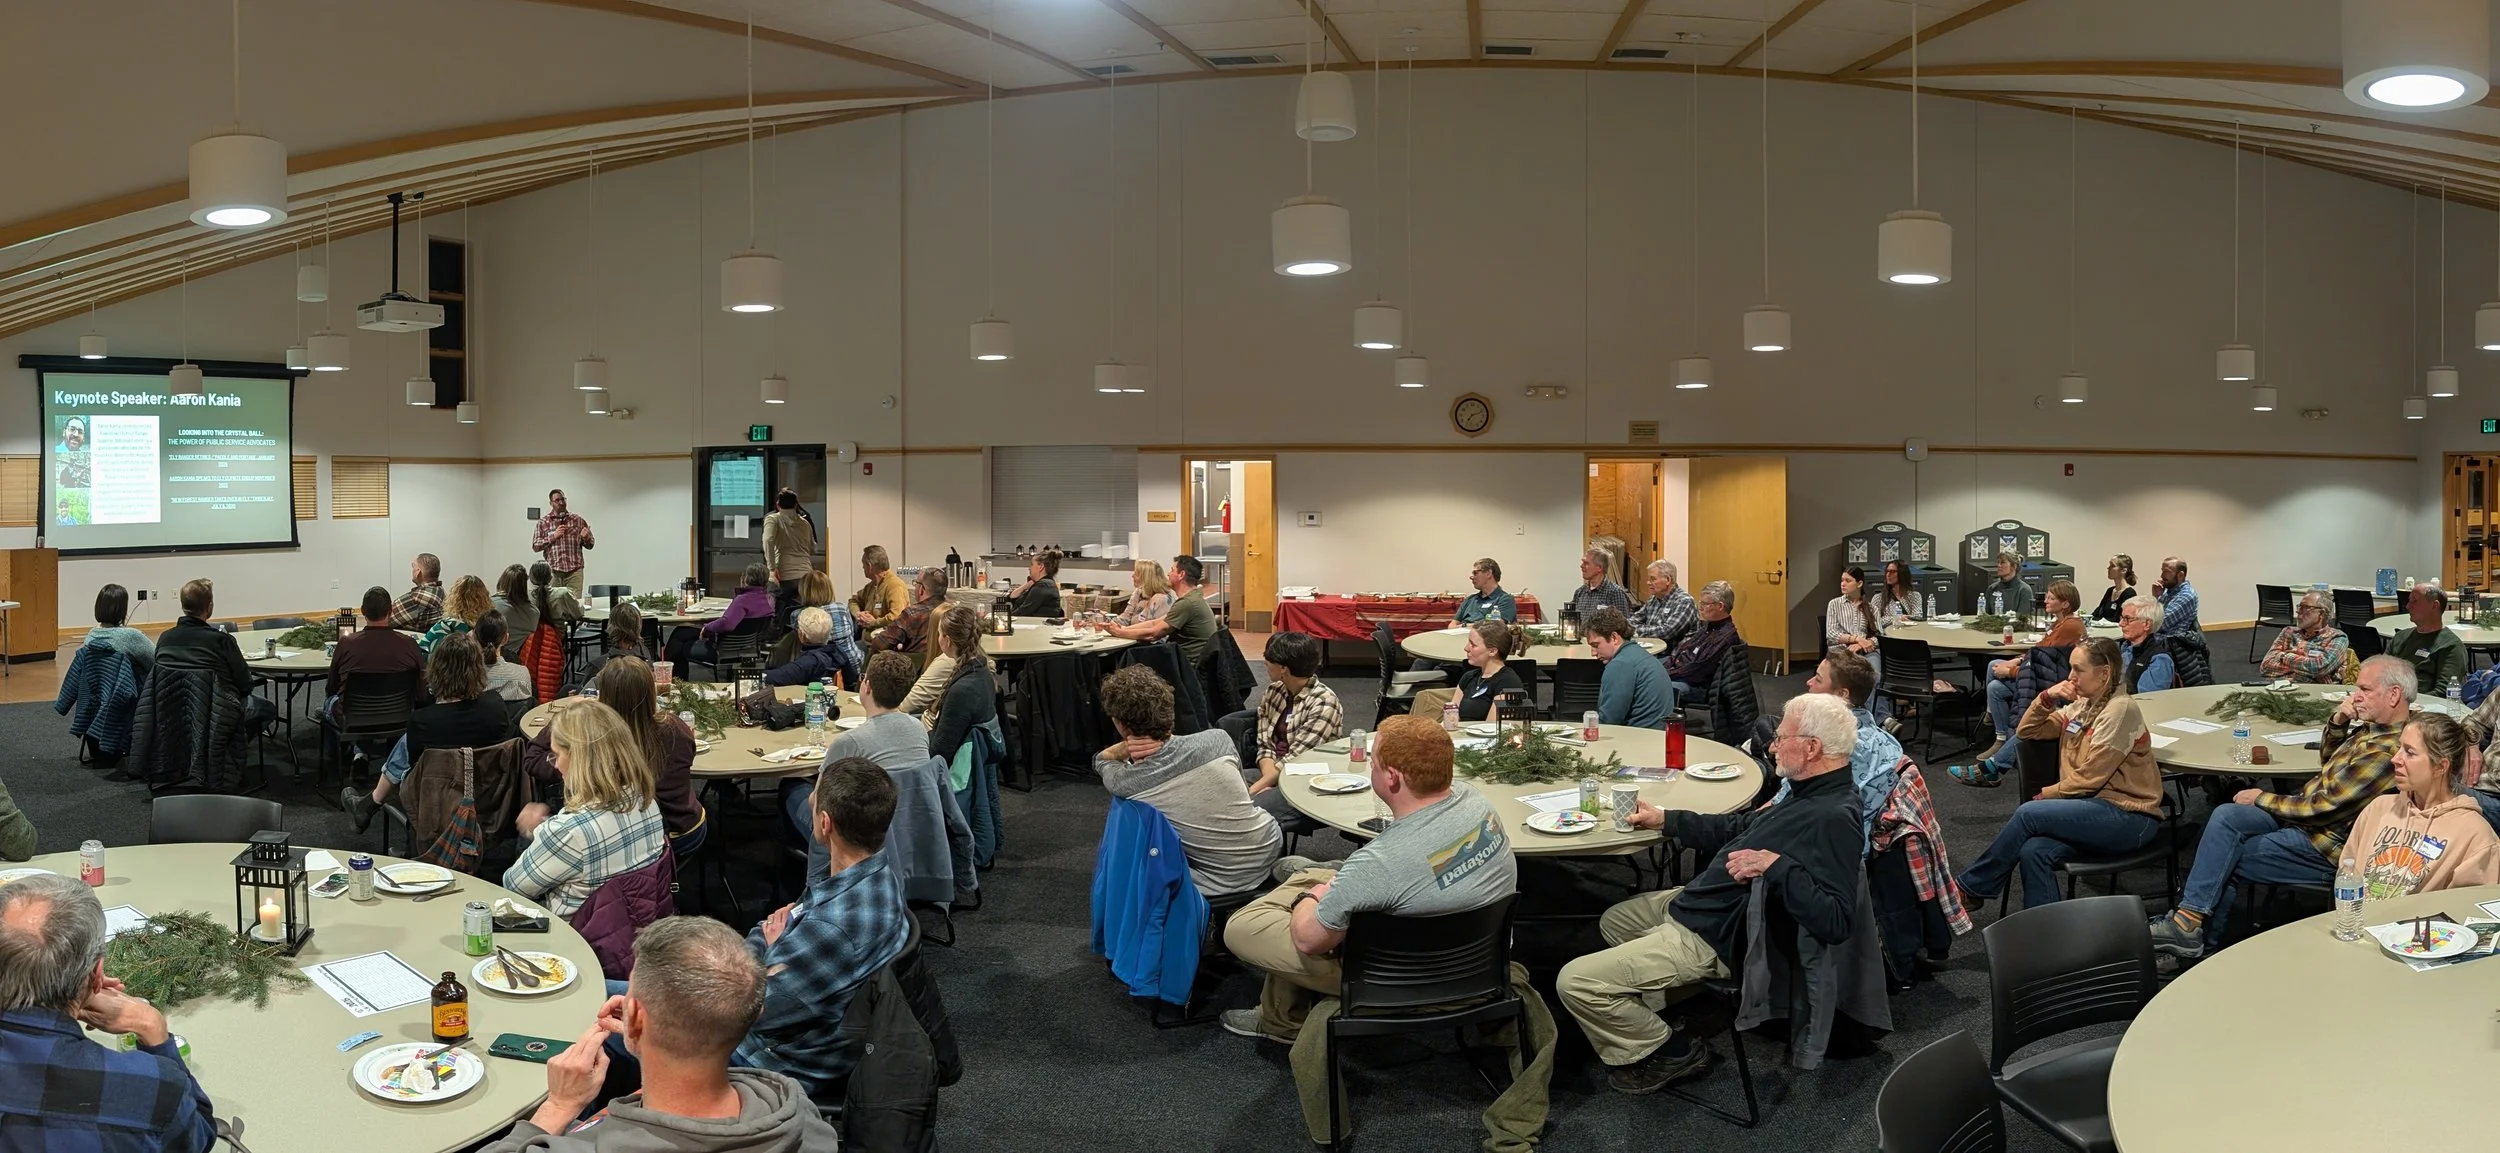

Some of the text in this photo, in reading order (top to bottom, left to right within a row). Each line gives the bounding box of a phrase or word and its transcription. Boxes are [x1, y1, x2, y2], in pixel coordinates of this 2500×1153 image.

[55, 390, 242, 408] Keynote Speaker: Aaron Kania
[753, 426, 767, 441] EXIT
[2484, 419, 2496, 433] EXIT
[179, 438, 198, 446] POWER
[198, 438, 206, 446] OF
[206, 438, 225, 446] PUBLIC
[2373, 825, 2448, 859] COLOR
[1442, 833, 1503, 887] patagonia
